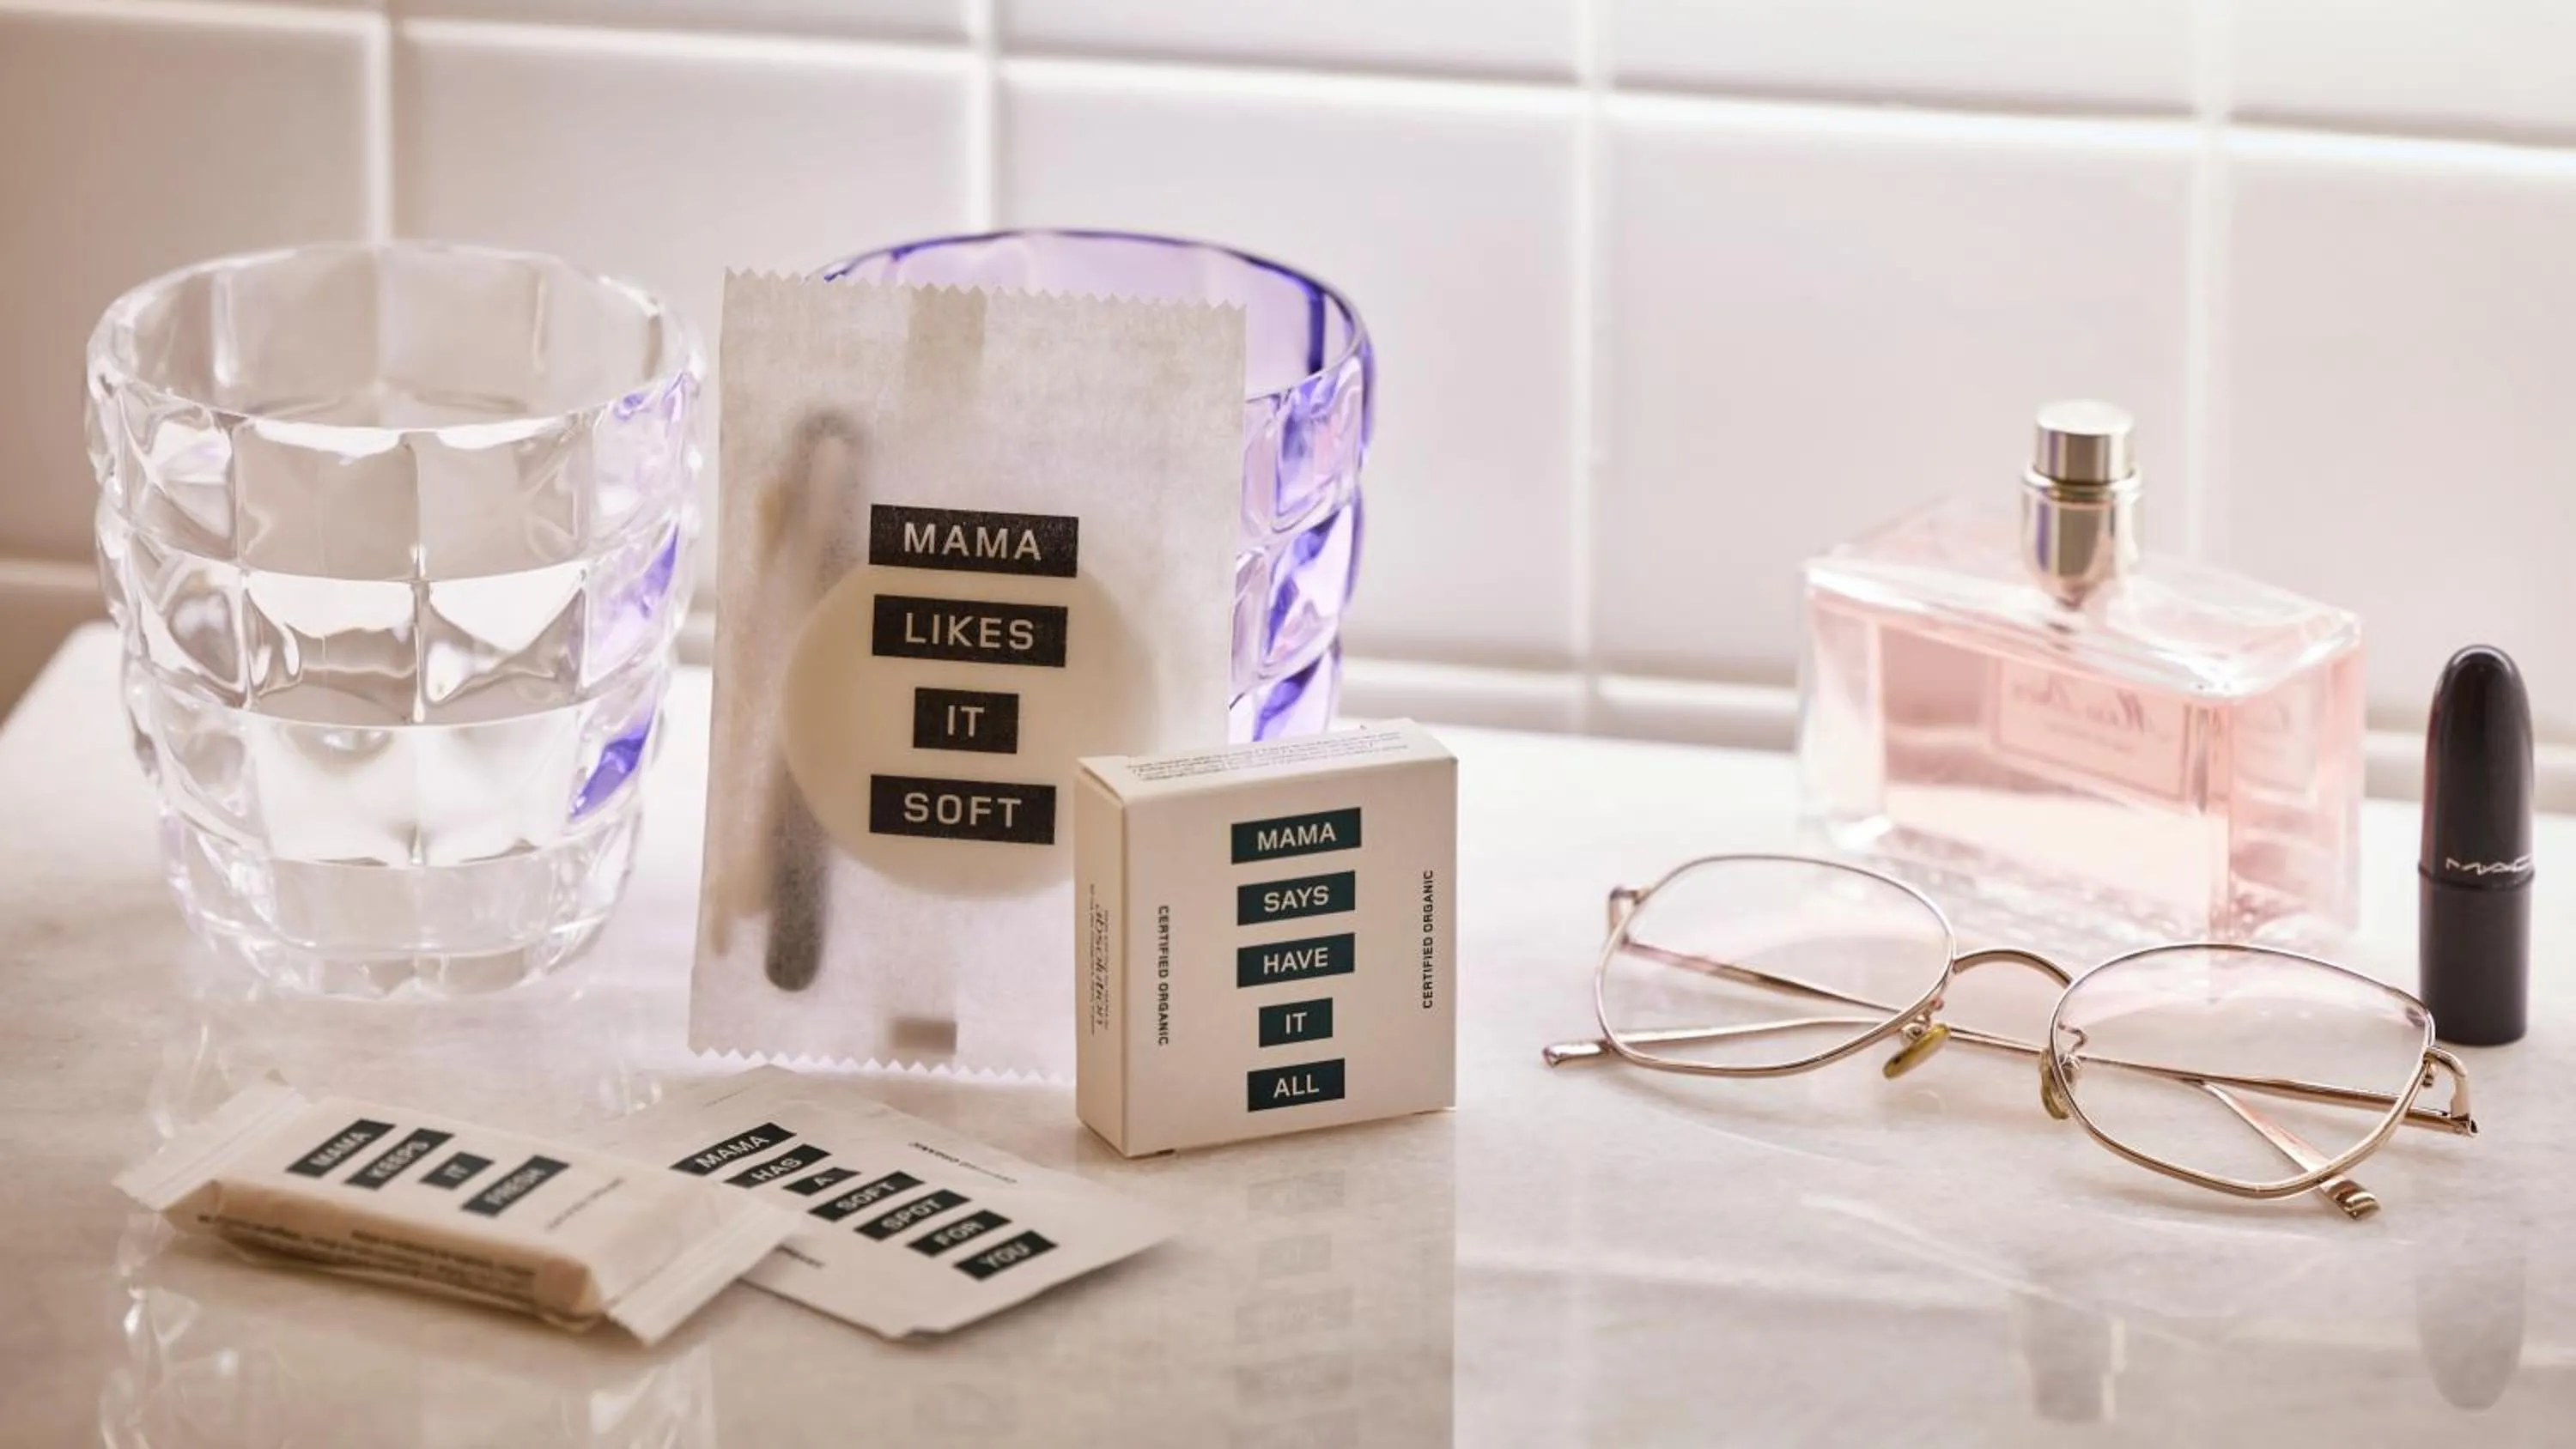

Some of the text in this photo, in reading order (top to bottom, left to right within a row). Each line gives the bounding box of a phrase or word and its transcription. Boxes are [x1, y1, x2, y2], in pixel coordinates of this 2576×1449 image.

[903, 522, 1042, 561] MAMA
[905, 612, 1034, 651] LIKES
[946, 704, 985, 737] IT
[903, 791, 1022, 828] SOFT
[1256, 822, 1337, 852] MAMA
[1263, 885, 1329, 912] SAYS
[1423, 870, 1434, 1009] CERTIFIED ORGANIC
[1262, 946, 1328, 975] HAVE
[1157, 906, 1170, 1046] CERTIFIED ORGANIC
[1285, 1011, 1308, 1034] IT
[1273, 1073, 1320, 1099] ALL
[308, 1130, 372, 1167] MAMA
[366, 1139, 430, 1179] KEEPS
[696, 1134, 770, 1168] MAMA
[443, 1163, 470, 1181] IT
[749, 1157, 803, 1182] HAS
[813, 1175, 834, 1187] A
[835, 1181, 896, 1211] SOFT
[880, 1198, 942, 1230] SPOT
[932, 1220, 986, 1246] FOR
[975, 1240, 1030, 1269] YOU
